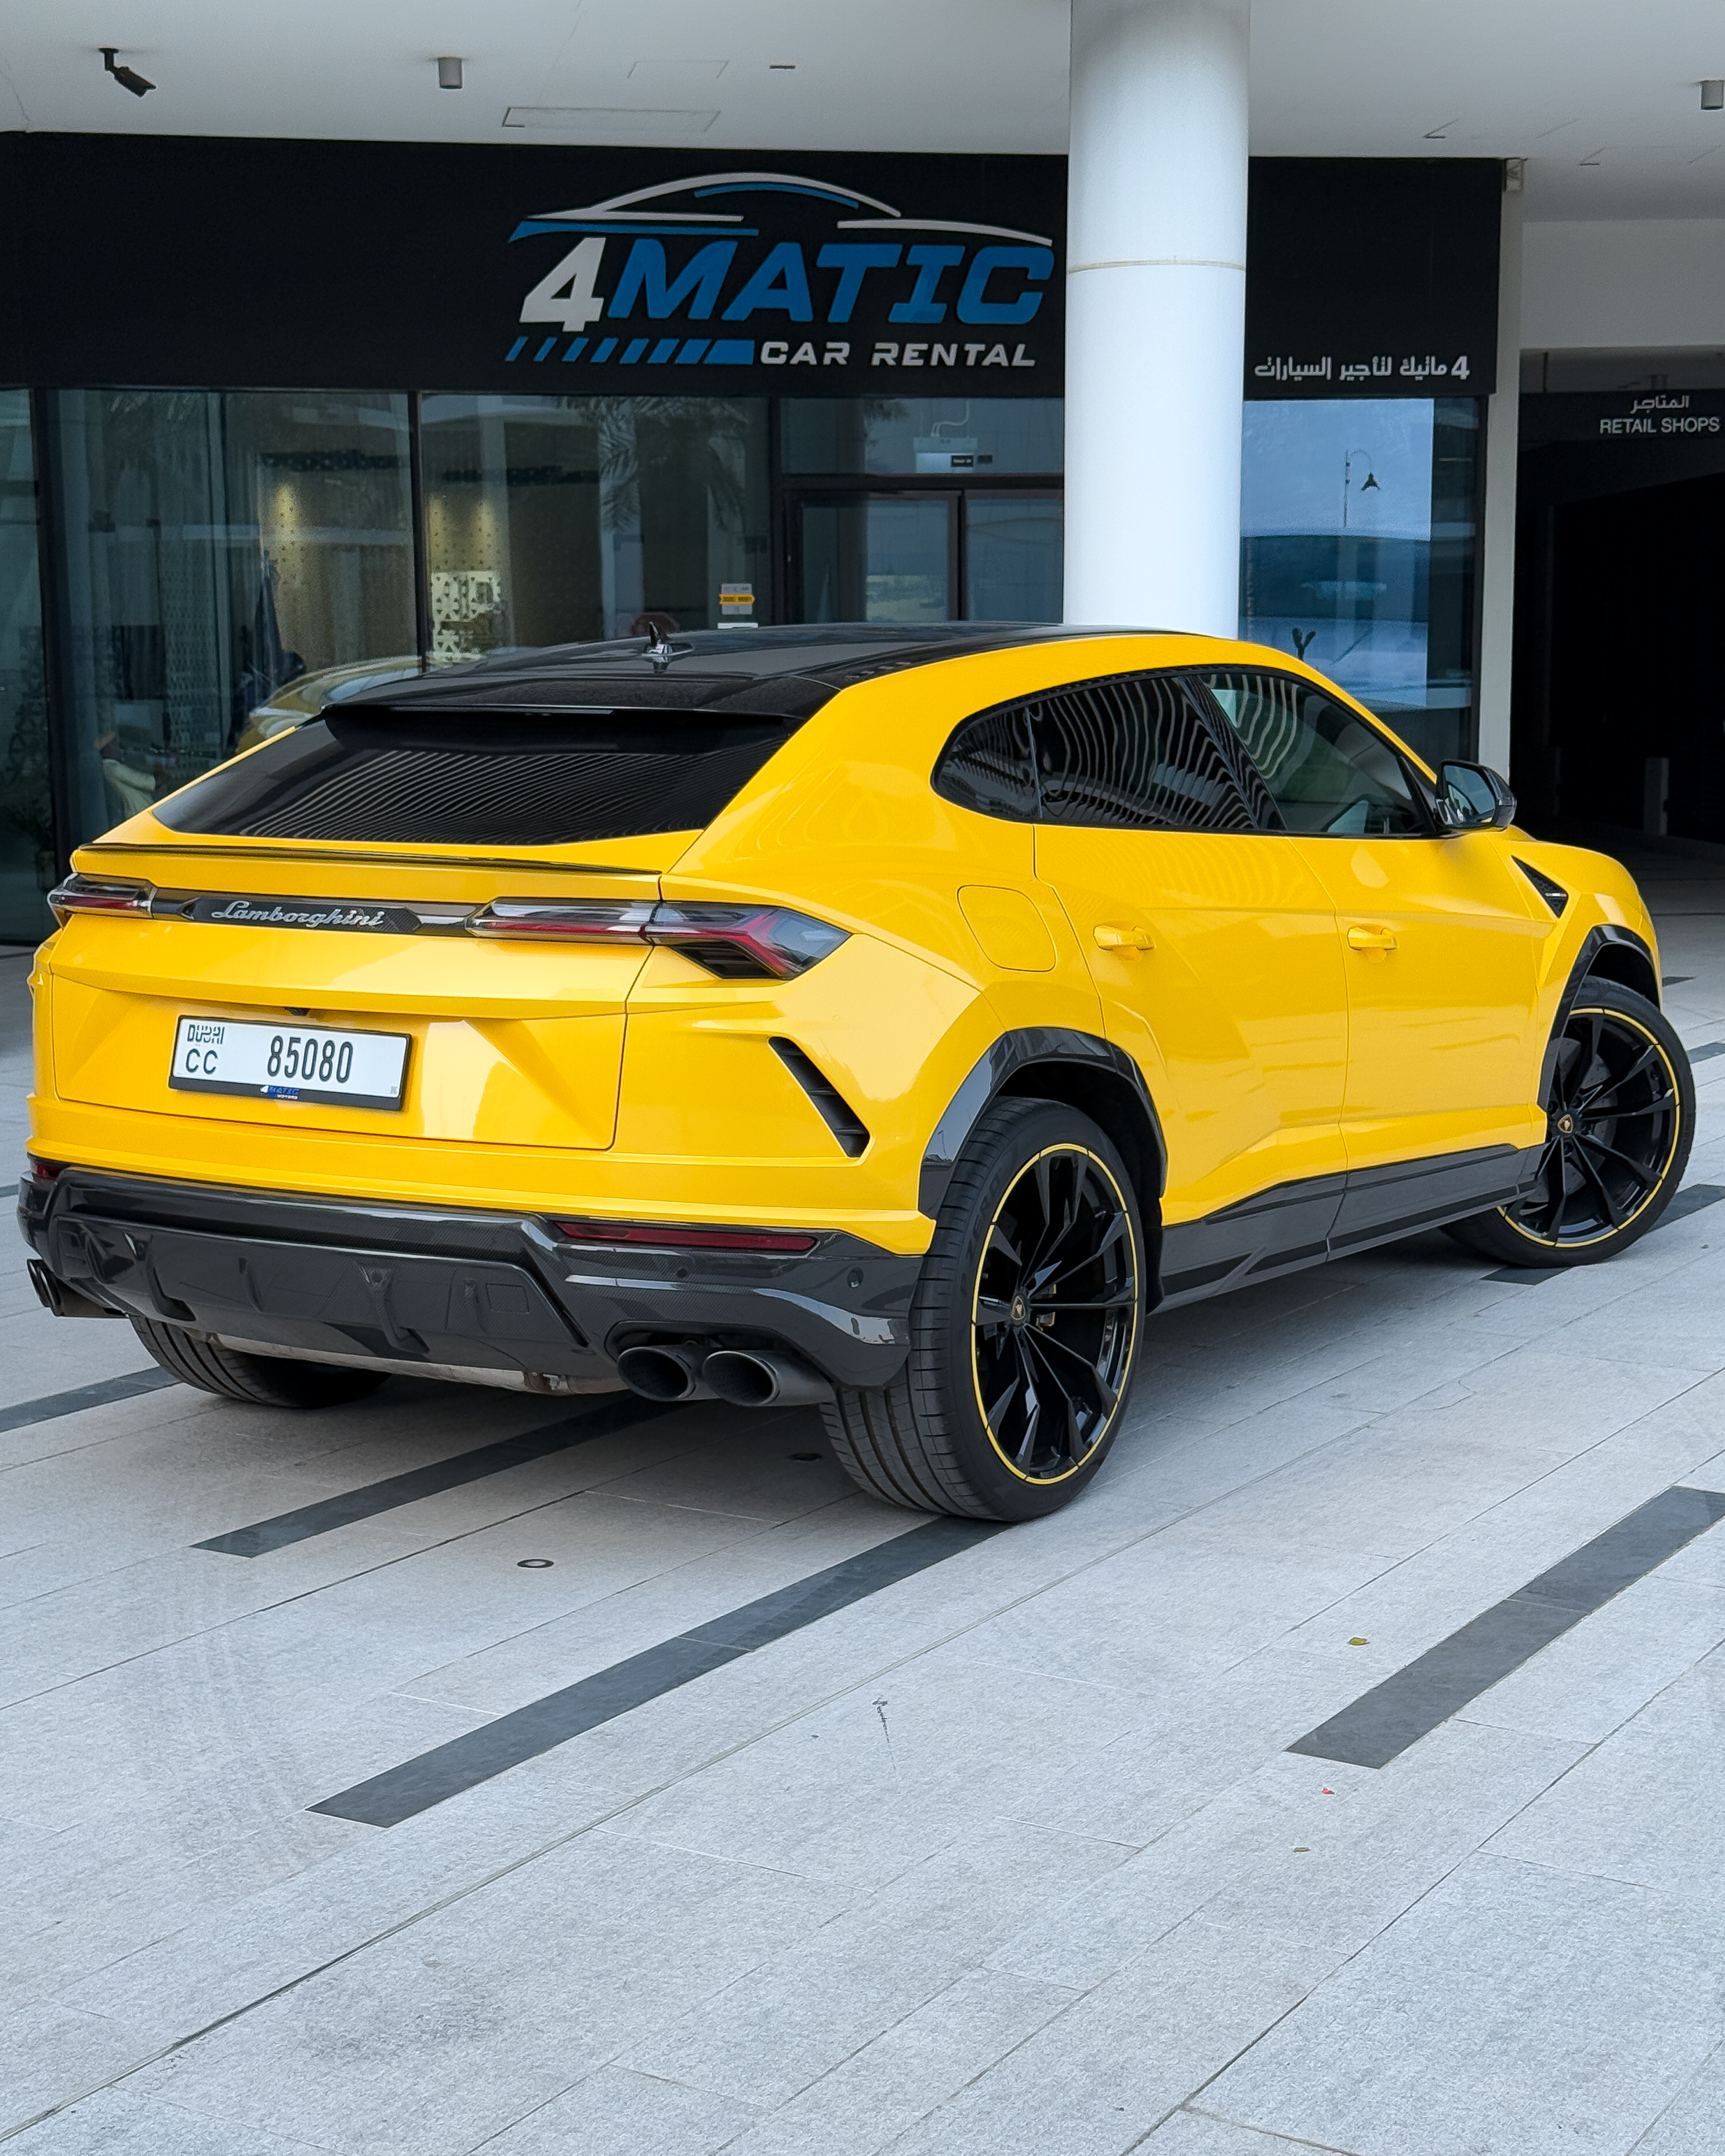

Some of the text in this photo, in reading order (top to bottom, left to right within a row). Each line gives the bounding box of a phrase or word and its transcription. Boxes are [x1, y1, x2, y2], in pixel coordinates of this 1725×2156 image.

[519, 237, 1054, 332] 4MATIC
[760, 341, 1036, 367] CAR RENTAL
[1254, 355, 1470, 382] 4 ماتيك لتأجير السيارات
[1630, 394, 1690, 414] المتاجر
[1599, 416, 1721, 434] RETAIL SHOPS
[211, 900, 385, 927] Lamborghini
[186, 1035, 353, 1083] CC 85080
